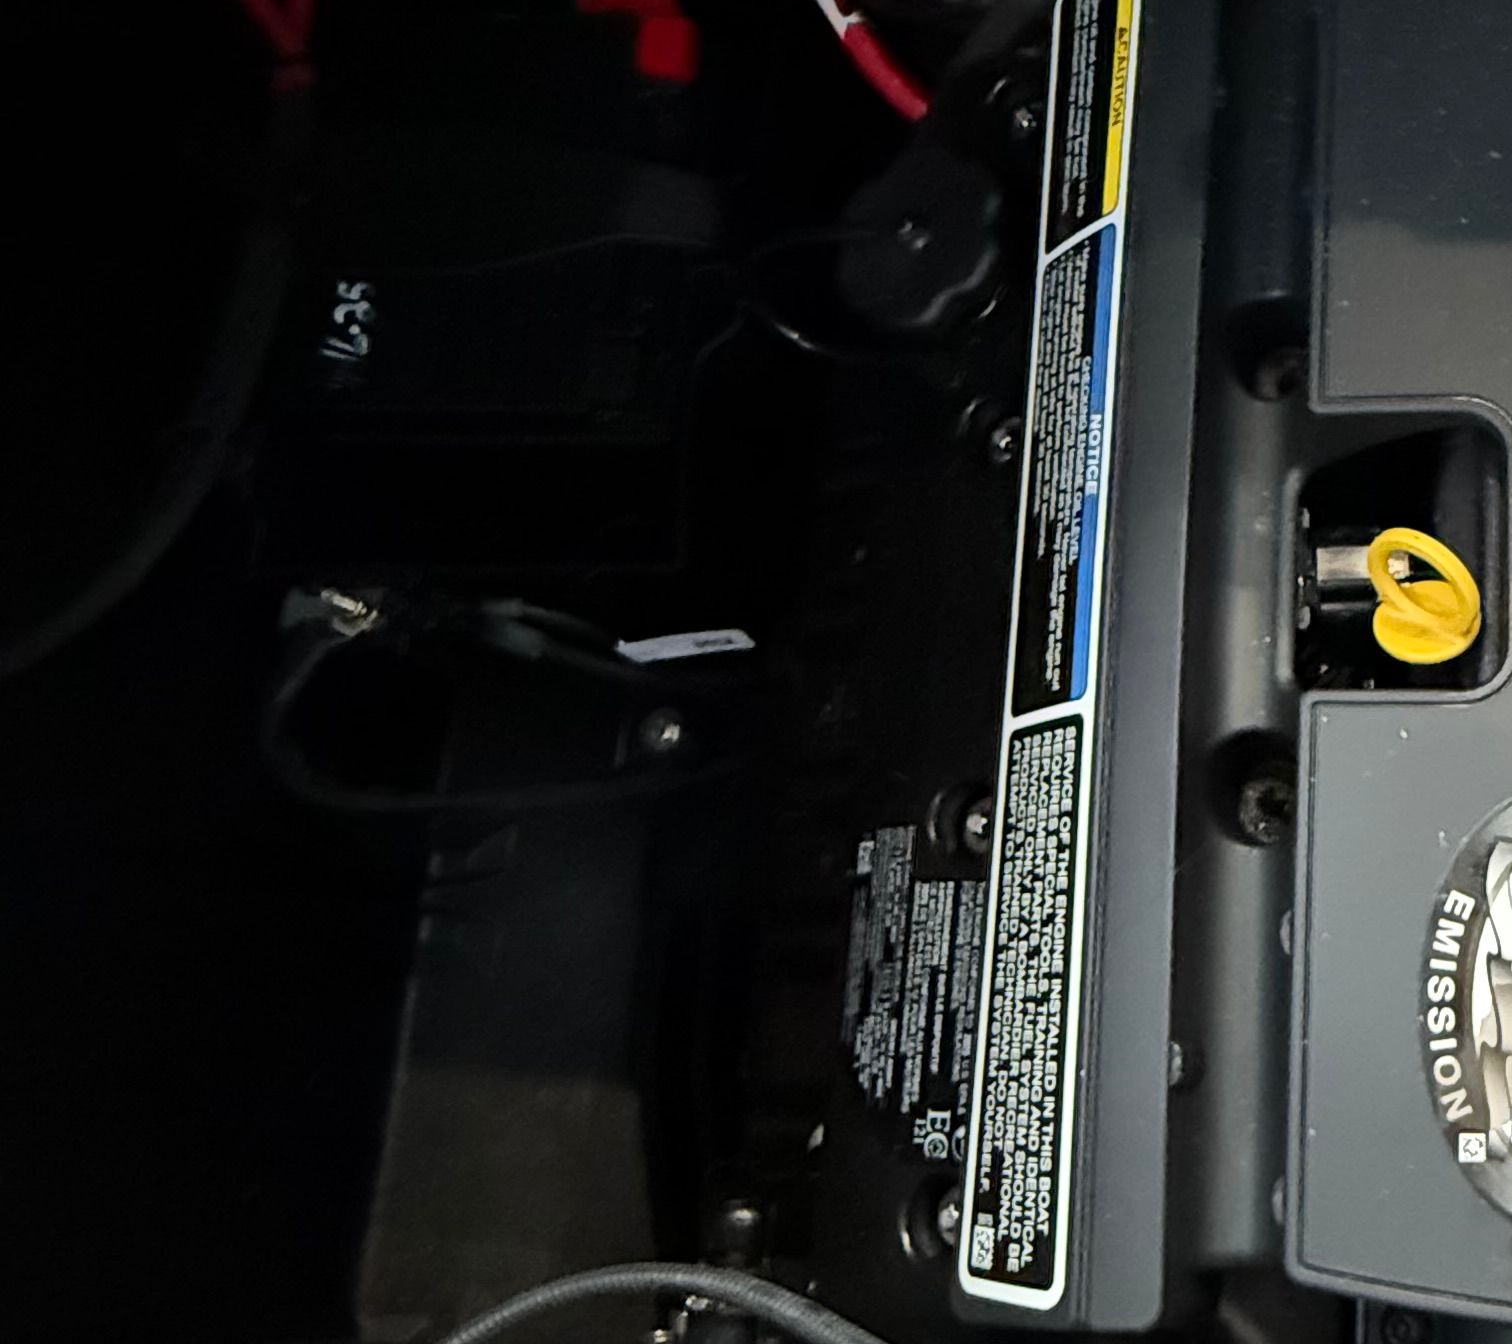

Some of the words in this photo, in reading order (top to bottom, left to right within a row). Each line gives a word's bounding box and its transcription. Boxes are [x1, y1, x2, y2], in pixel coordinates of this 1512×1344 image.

[1110, 39, 1128, 127] CAUTION
[1083, 413, 1103, 495] NOTICE
[1005, 739, 1020, 824] ATTEMPT
[1013, 735, 1030, 844] PRODUCTS
[1025, 733, 1041, 832] SERVICED
[1032, 730, 1052, 877] REPLACEMENT
[1047, 727, 1064, 831] REQUIRES
[1060, 725, 1077, 811] SERVICE
[1002, 829, 1014, 857] TO
[1021, 835, 1034, 888] ONLY
[1055, 847, 1069, 890] THE
[1058, 815, 1071, 845] OF
[996, 860, 1012, 946] SERVICE
[1007, 847, 1023, 934] TRAINED
[1019, 891, 1031, 919] BY
[1041, 834, 1058, 920] SPECIAL
[993, 950, 1006, 991] THE
[1018, 922, 1029, 938] A
[1050, 894, 1067, 974] ENGINE
[1008, 940, 1027, 1076] BOMBARDIER
[1025, 955, 1038, 996] THE
[1427, 889, 1476, 1124] EMISSION
[987, 994, 1003, 1077] SYSTEM
[1021, 1001, 1035, 1055] FUEL
[1030, 1002, 1047, 1102] TRAINING
[1043, 978, 1062, 1092] INSTALLED
[992, 1105, 1005, 1150] NOT
[995, 1069, 1008, 1103] DO
[1015, 1059, 1031, 1145] SYSTEM
[1041, 1095, 1055, 1118] IN
[997, 1080, 1018, 1241] RECREATIONAL
[1026, 1105, 1041, 1151] AND
[1038, 1121, 1053, 1171] THIS
[1009, 1149, 1026, 1238] SHOULD
[1019, 1156, 1038, 1268] IDENTICAL
[1034, 1176, 1050, 1236] BOAT
[1007, 1242, 1020, 1272] BE
